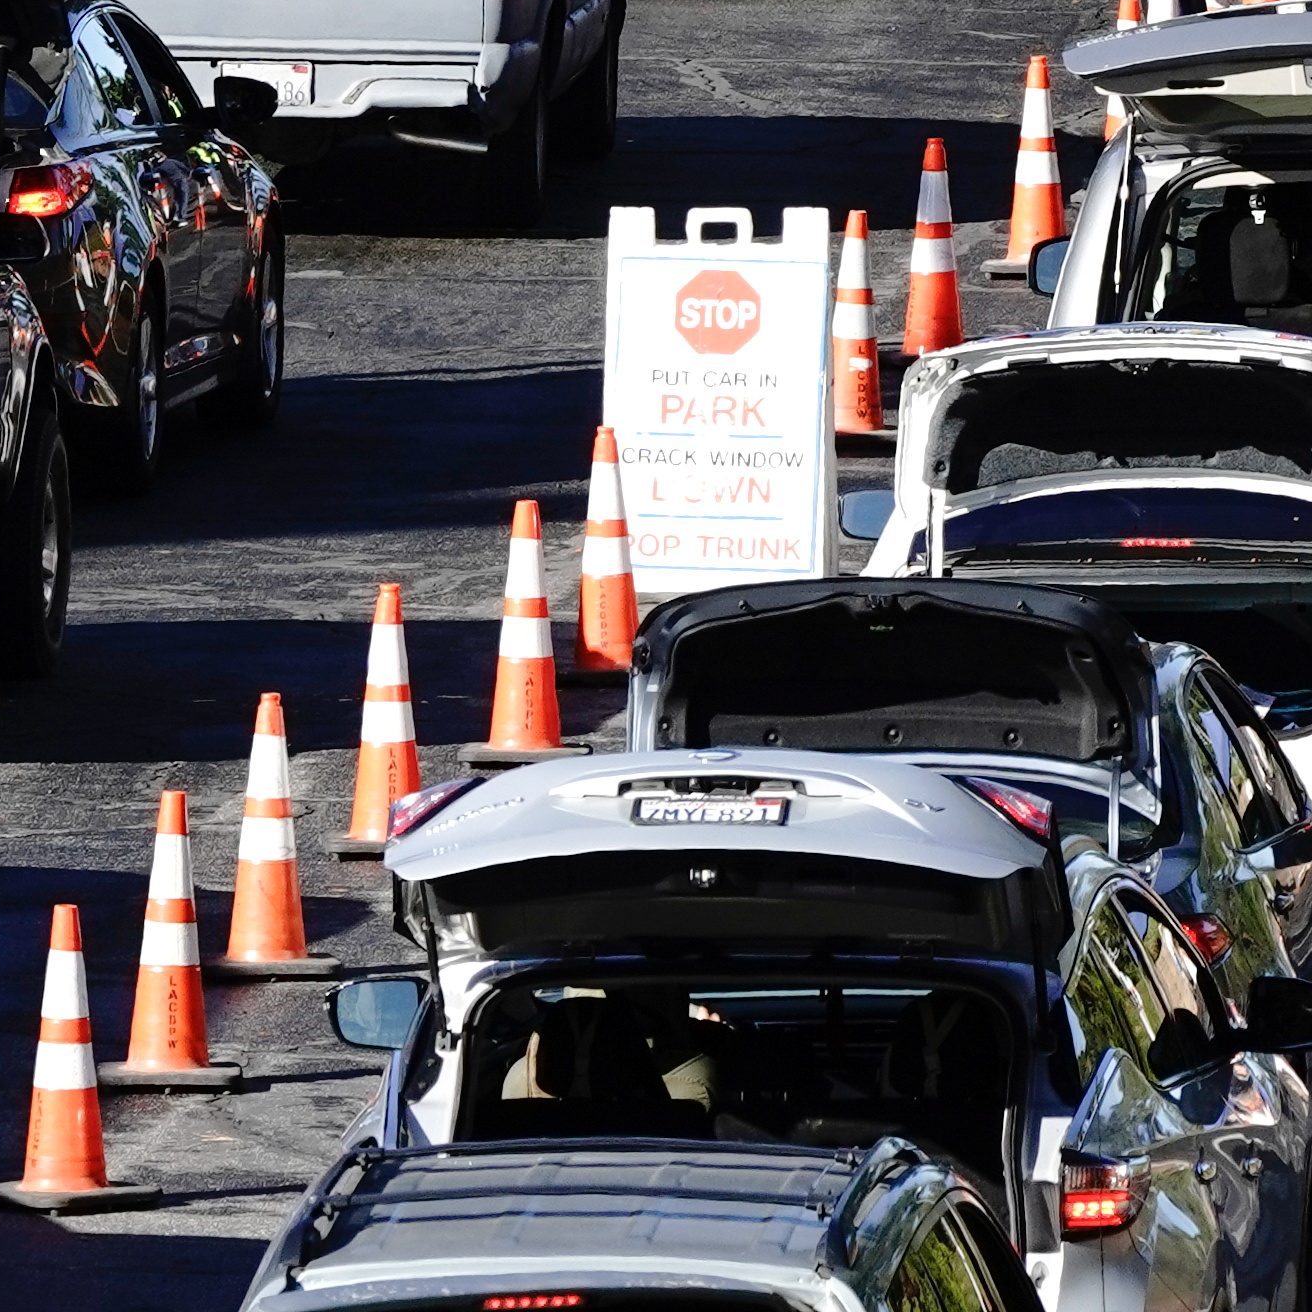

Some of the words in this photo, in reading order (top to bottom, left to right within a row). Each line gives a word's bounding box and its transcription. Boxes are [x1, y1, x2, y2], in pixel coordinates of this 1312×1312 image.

[680, 298, 757, 330] STOP
[652, 370, 690, 386] PUT
[703, 371, 747, 388] CAR
[759, 374, 777, 388] IN
[856, 346, 868, 418] LCDPW
[660, 395, 766, 427] PARK
[622, 448, 697, 466] CRACK
[710, 451, 804, 468] WINDOW
[697, 536, 801, 561] TRUNK
[168, 975, 179, 1049] LACDPW
